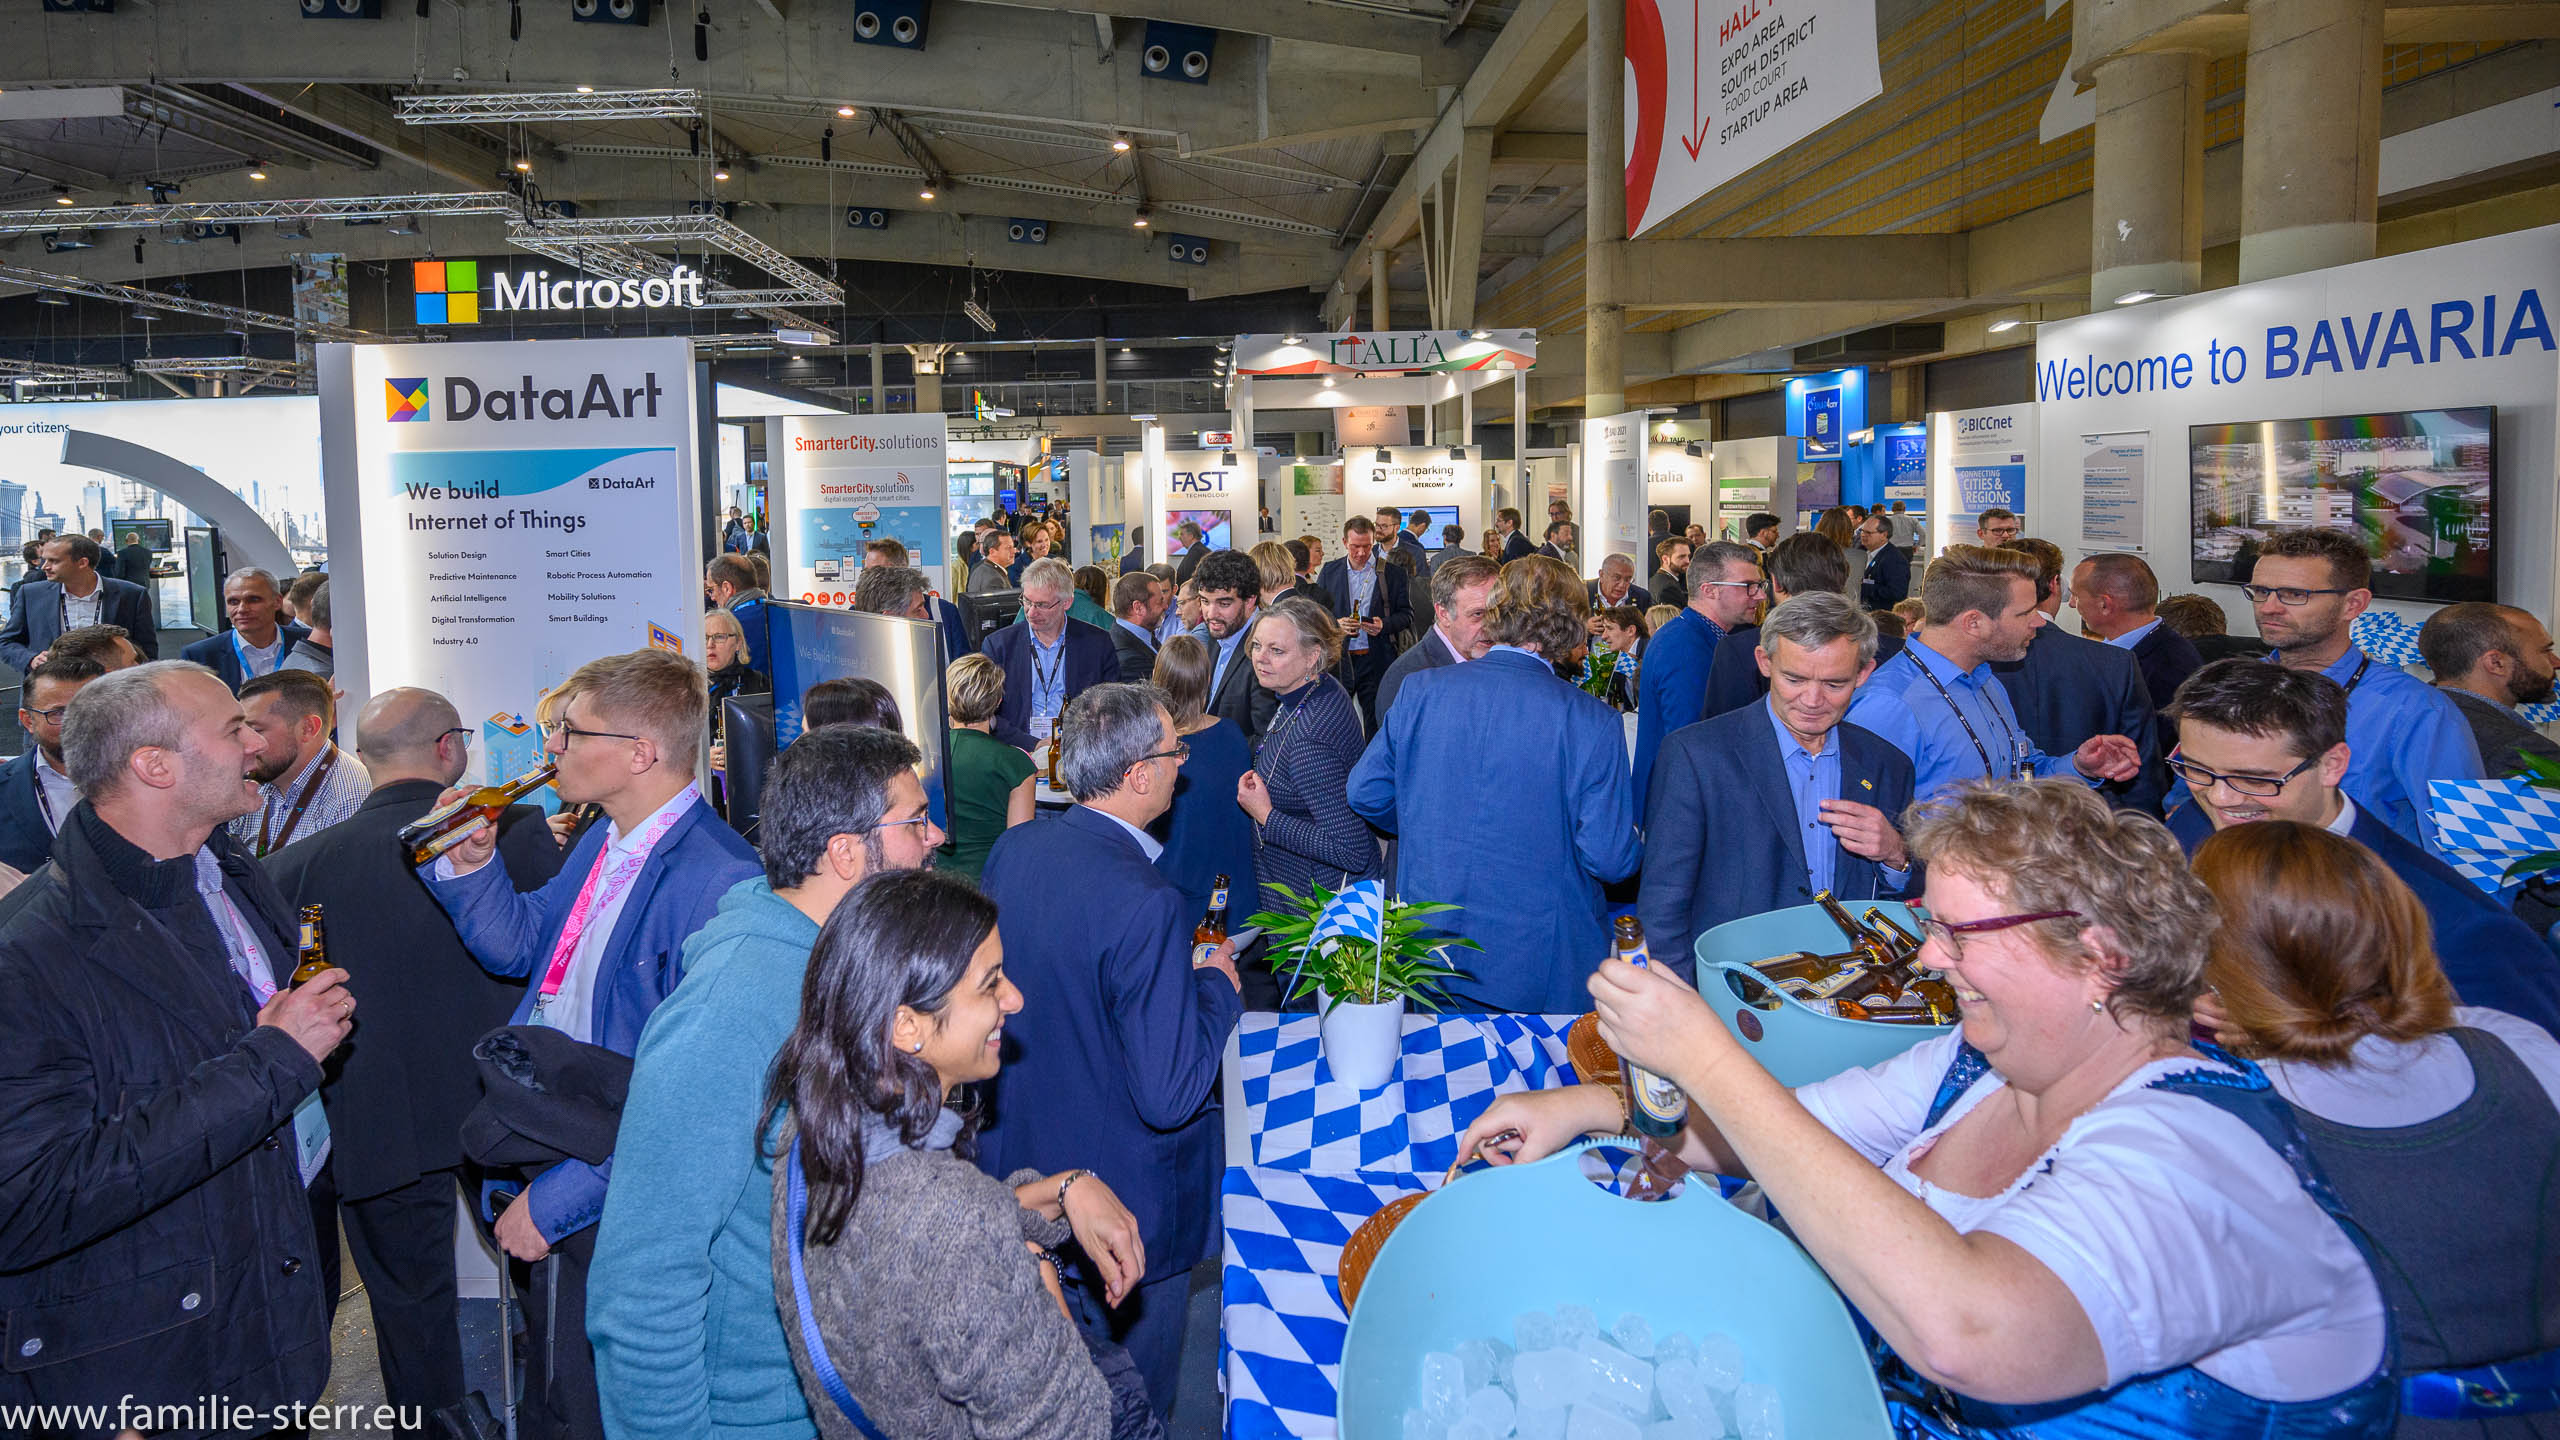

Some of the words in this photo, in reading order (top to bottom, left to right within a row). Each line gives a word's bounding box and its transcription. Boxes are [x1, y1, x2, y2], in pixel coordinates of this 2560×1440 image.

[1720, 0, 1760, 47] HALL
[1721, 42, 1749, 76] EXPO
[1751, 14, 1785, 52] AREA
[1721, 60, 1756, 99] SOUTH
[1760, 14, 1816, 71] DISTRICT
[1725, 88, 1751, 116] FOOD
[1753, 61, 1787, 95] COURT
[1720, 100, 1770, 145] STARTUP
[1774, 76, 1808, 112] AREA
[493, 265, 704, 311] Microsoft
[1328, 336, 1449, 365] ITALIA
[2036, 353, 2193, 402] Welcome
[2210, 337, 2247, 386] to
[2265, 288, 2557, 380] BAVARIA
[444, 372, 663, 422] DataArt
[26, 421, 70, 433] citizens
[1968, 416, 2013, 432] BICCnet
[795, 434, 938, 453] SmarterCity.solutions
[1960, 469, 2001, 478] CONNECTING
[602, 476, 656, 490] DataArt
[820, 481, 915, 495] SmarterCity.solutions
[1172, 471, 1229, 492] FAST
[1963, 478, 1993, 490] CITIES
[1994, 477, 2003, 490] &
[405, 481, 442, 500] We
[448, 479, 500, 499] build
[823, 495, 842, 503] digital
[1966, 490, 2011, 504] REGIONS
[408, 511, 489, 531] Internet
[494, 509, 515, 529] of
[520, 509, 586, 533] Things
[428, 551, 459, 560] Solution
[461, 551, 487, 561] Design
[545, 550, 569, 558] Smart
[570, 549, 591, 558] Cities
[429, 572, 466, 581] Predictive
[468, 572, 517, 580] Maintenance
[546, 571, 575, 579] Robotic
[577, 571, 606, 579] Process
[607, 570, 652, 579] Automation
[431, 594, 462, 602] Artificial
[463, 593, 507, 604] Intelligence
[547, 593, 579, 602] Mobility
[581, 592, 616, 600] Solutions
[431, 615, 457, 626] Digital
[458, 615, 515, 623] Transformation
[548, 614, 572, 622] Smart
[573, 613, 608, 623] Buildings
[432, 637, 464, 647] Industry
[465, 637, 479, 645] 4.0
